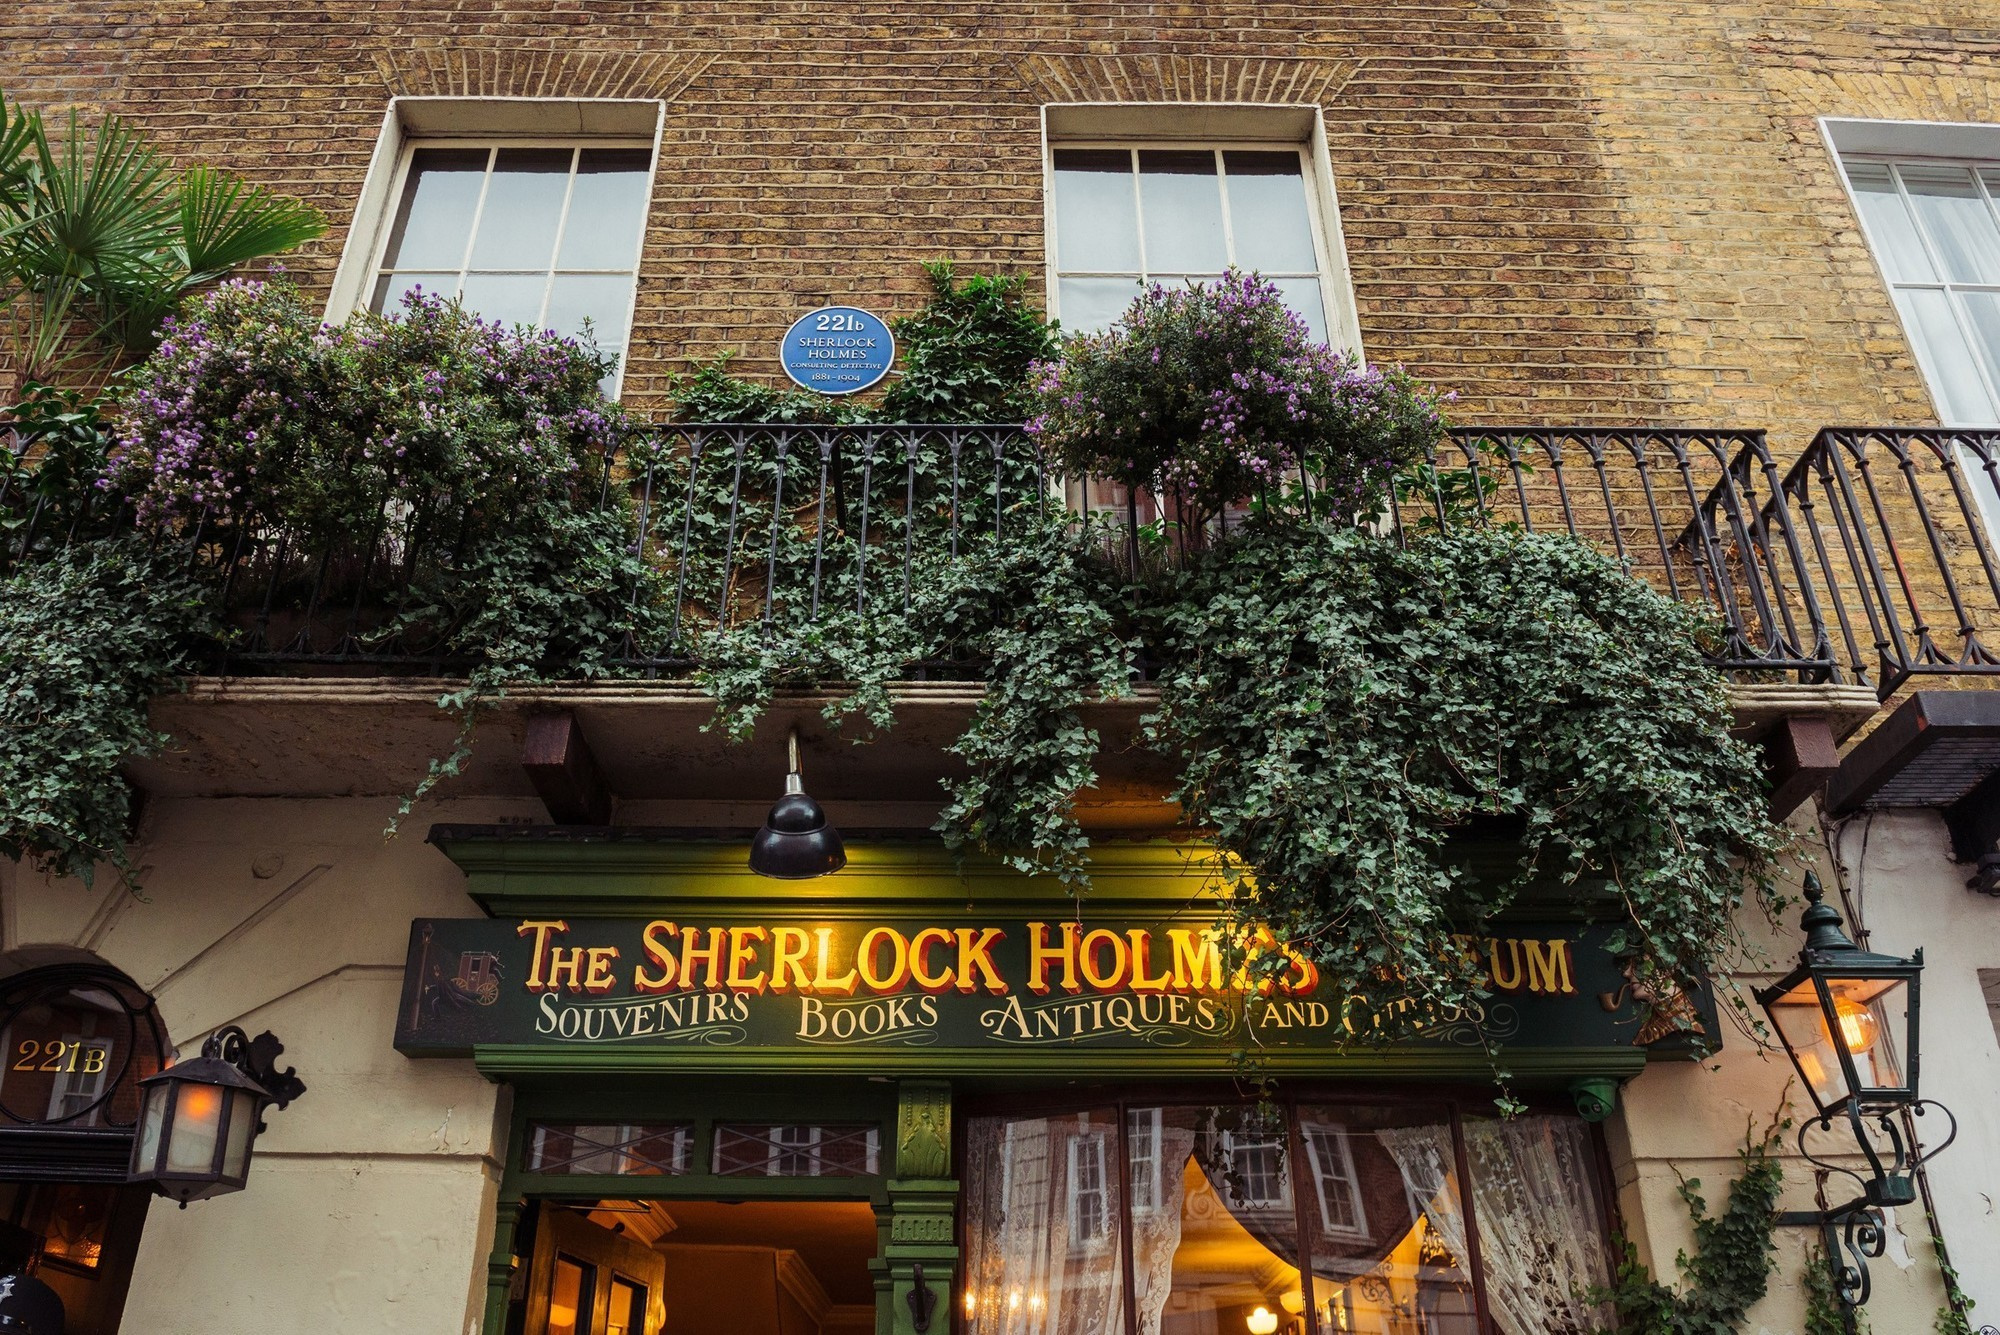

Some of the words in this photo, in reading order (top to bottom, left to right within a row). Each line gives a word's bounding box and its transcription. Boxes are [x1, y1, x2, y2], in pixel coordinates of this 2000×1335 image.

[816, 314, 865, 332] 221b
[799, 337, 876, 348] SHERLOCK
[808, 349, 867, 359] HOLMES
[517, 919, 621, 993] THE
[635, 920, 1008, 995] SHERLOCK
[535, 991, 750, 1039] SOUVENIRS
[796, 995, 938, 1038] BOOKS
[980, 994, 1216, 1038] ANTIQUES
[1259, 1002, 1330, 1028] AND
[13, 1039, 106, 1073] 221B
